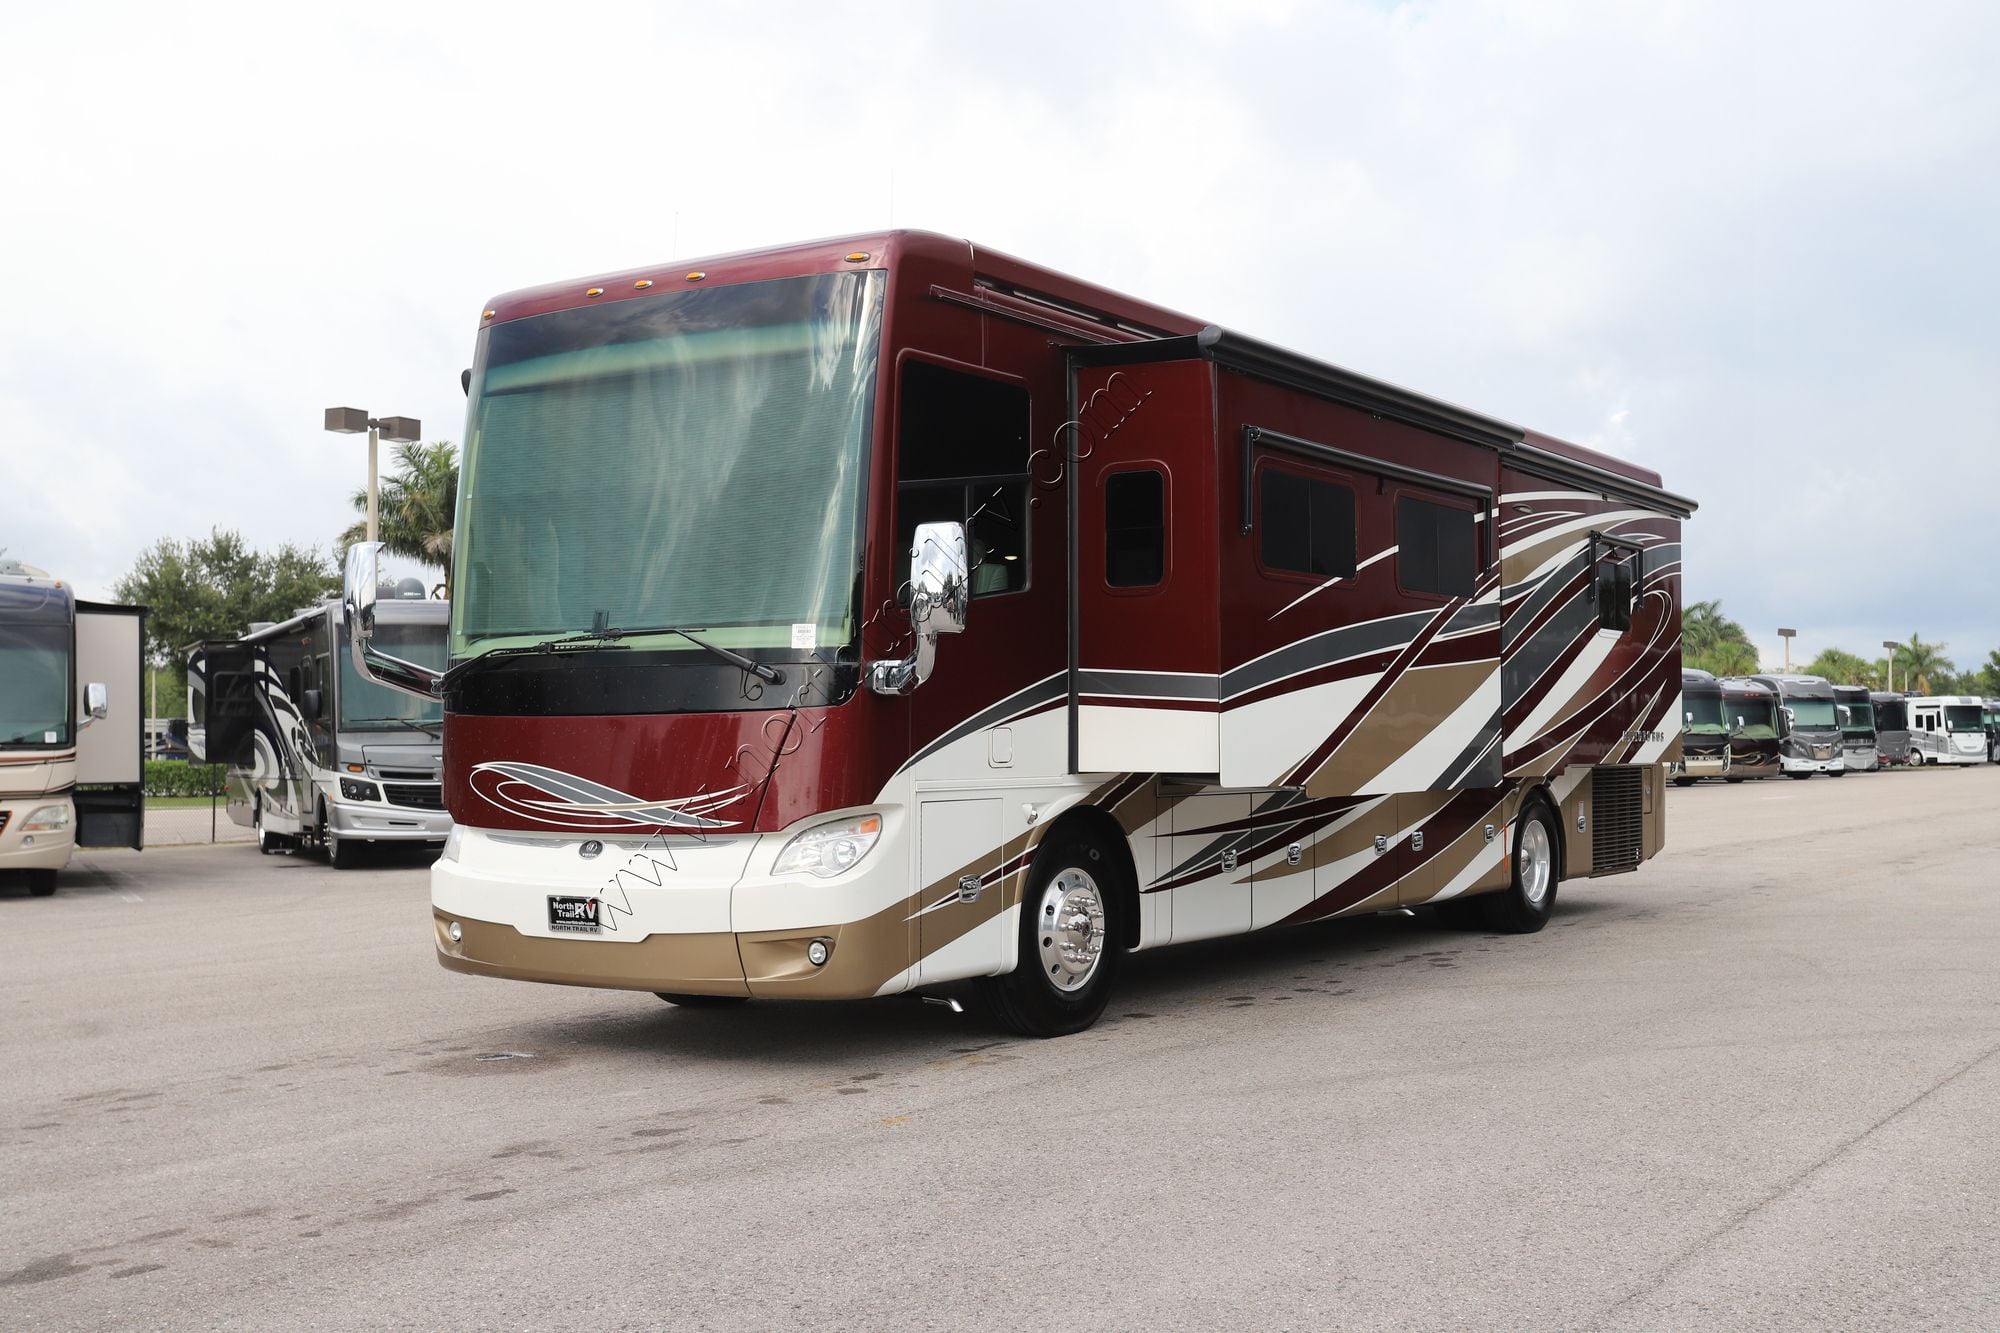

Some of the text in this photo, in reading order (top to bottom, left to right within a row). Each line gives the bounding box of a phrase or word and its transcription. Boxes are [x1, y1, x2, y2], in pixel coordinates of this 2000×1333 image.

[552, 901, 574, 910] North
[557, 909, 575, 918] Trail
[574, 902, 597, 919] RV
